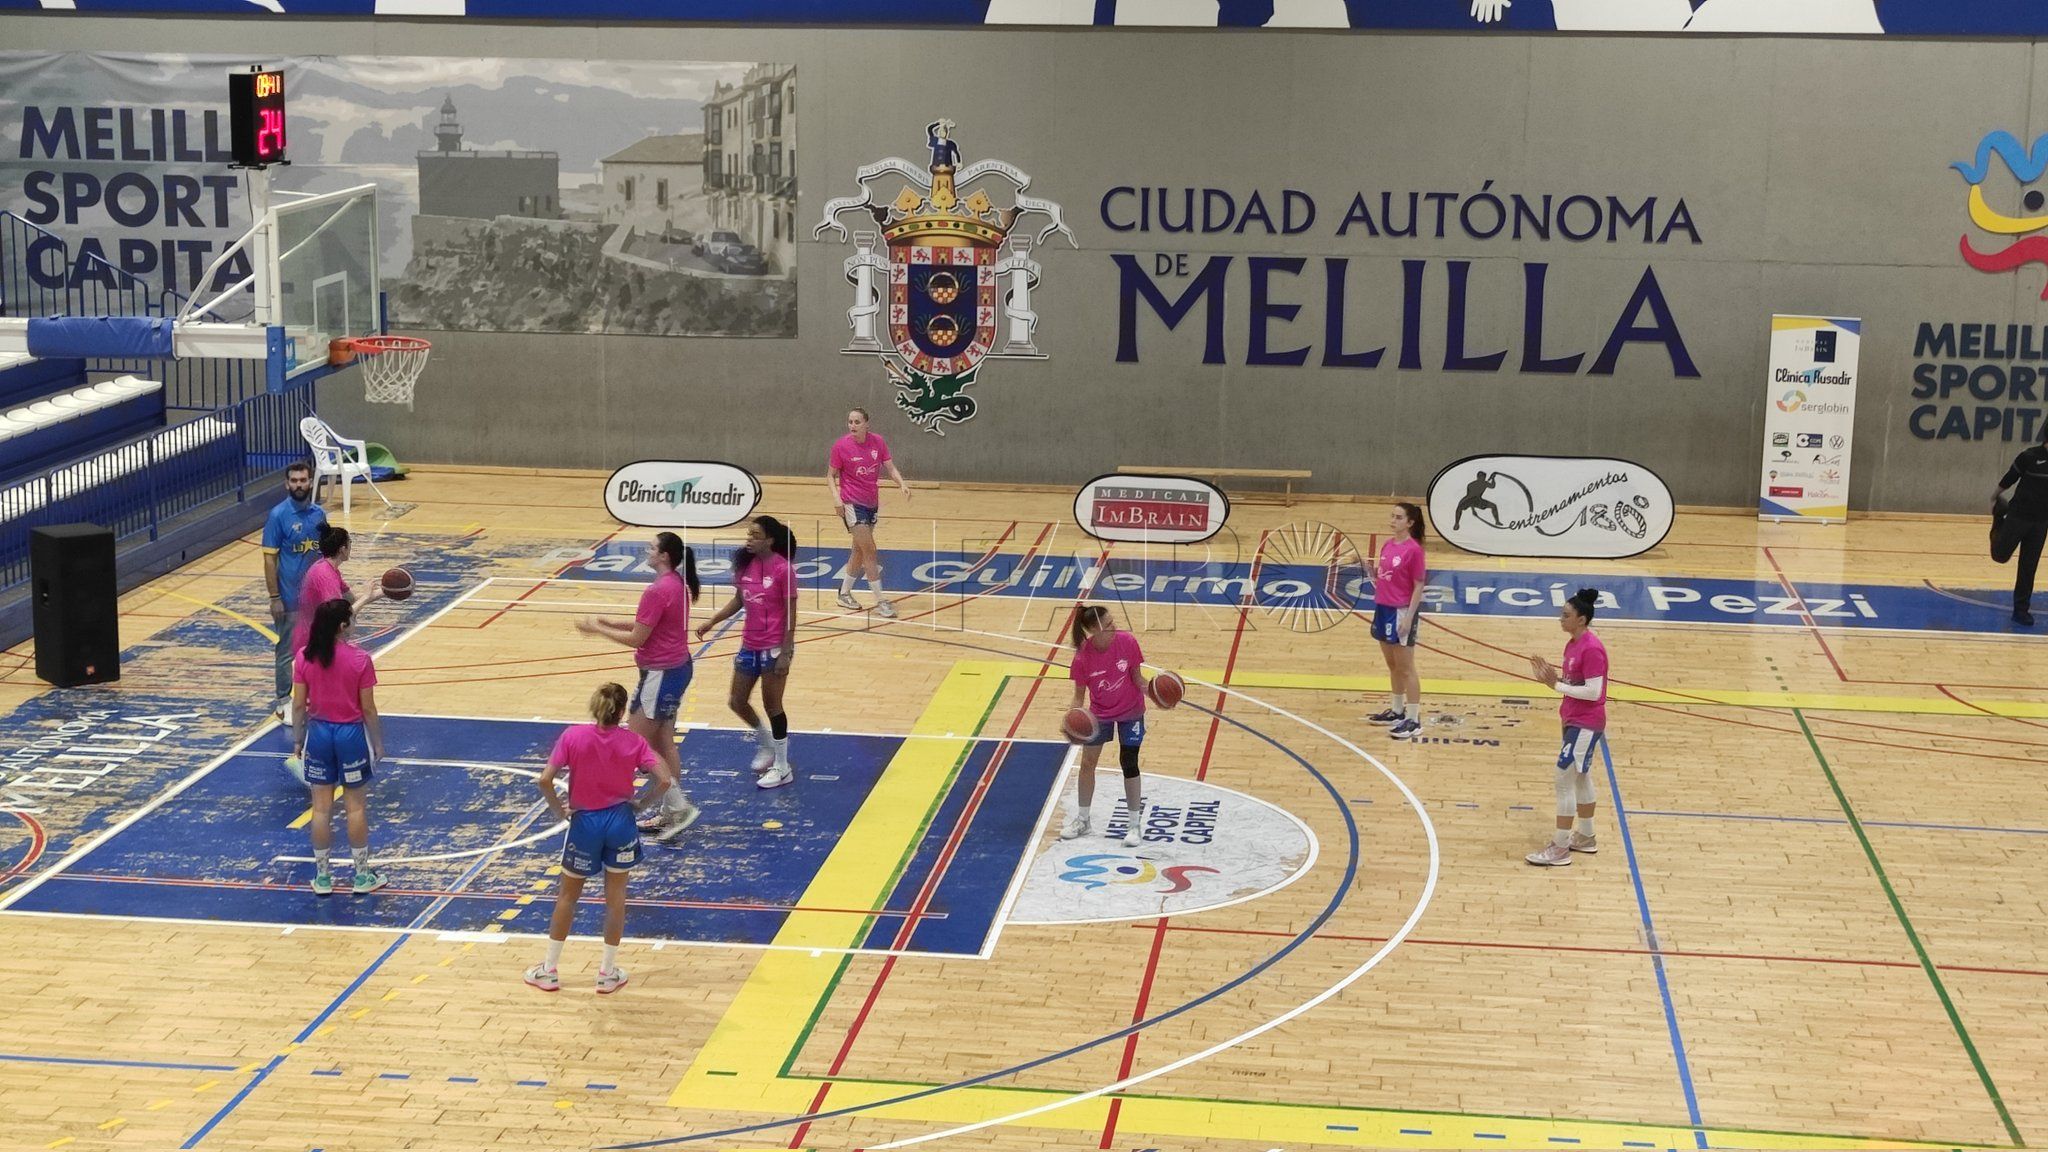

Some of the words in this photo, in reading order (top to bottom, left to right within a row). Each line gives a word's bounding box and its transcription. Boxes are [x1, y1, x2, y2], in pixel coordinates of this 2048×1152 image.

[19, 105, 233, 162] MELILL
[258, 109, 284, 154] 24
[23, 170, 238, 228] SPORT
[1100, 186, 1317, 236] CIUDAD
[1335, 180, 1704, 245] AUTÓNOMA
[25, 236, 256, 294] CAPITA
[1155, 253, 1190, 277] DE
[1109, 253, 1704, 379] MELILLA
[1912, 322, 2048, 360] MELIL
[618, 480, 676, 503] Clínica
[680, 482, 745, 506] Rusadir
[1100, 489, 1203, 502] MEDICAL
[911, 560, 1311, 599] Guillermo
[1646, 586, 1878, 619] Pezzi
[1142, 805, 1181, 842] SPORT
[1180, 800, 1220, 844] CAPITAL
